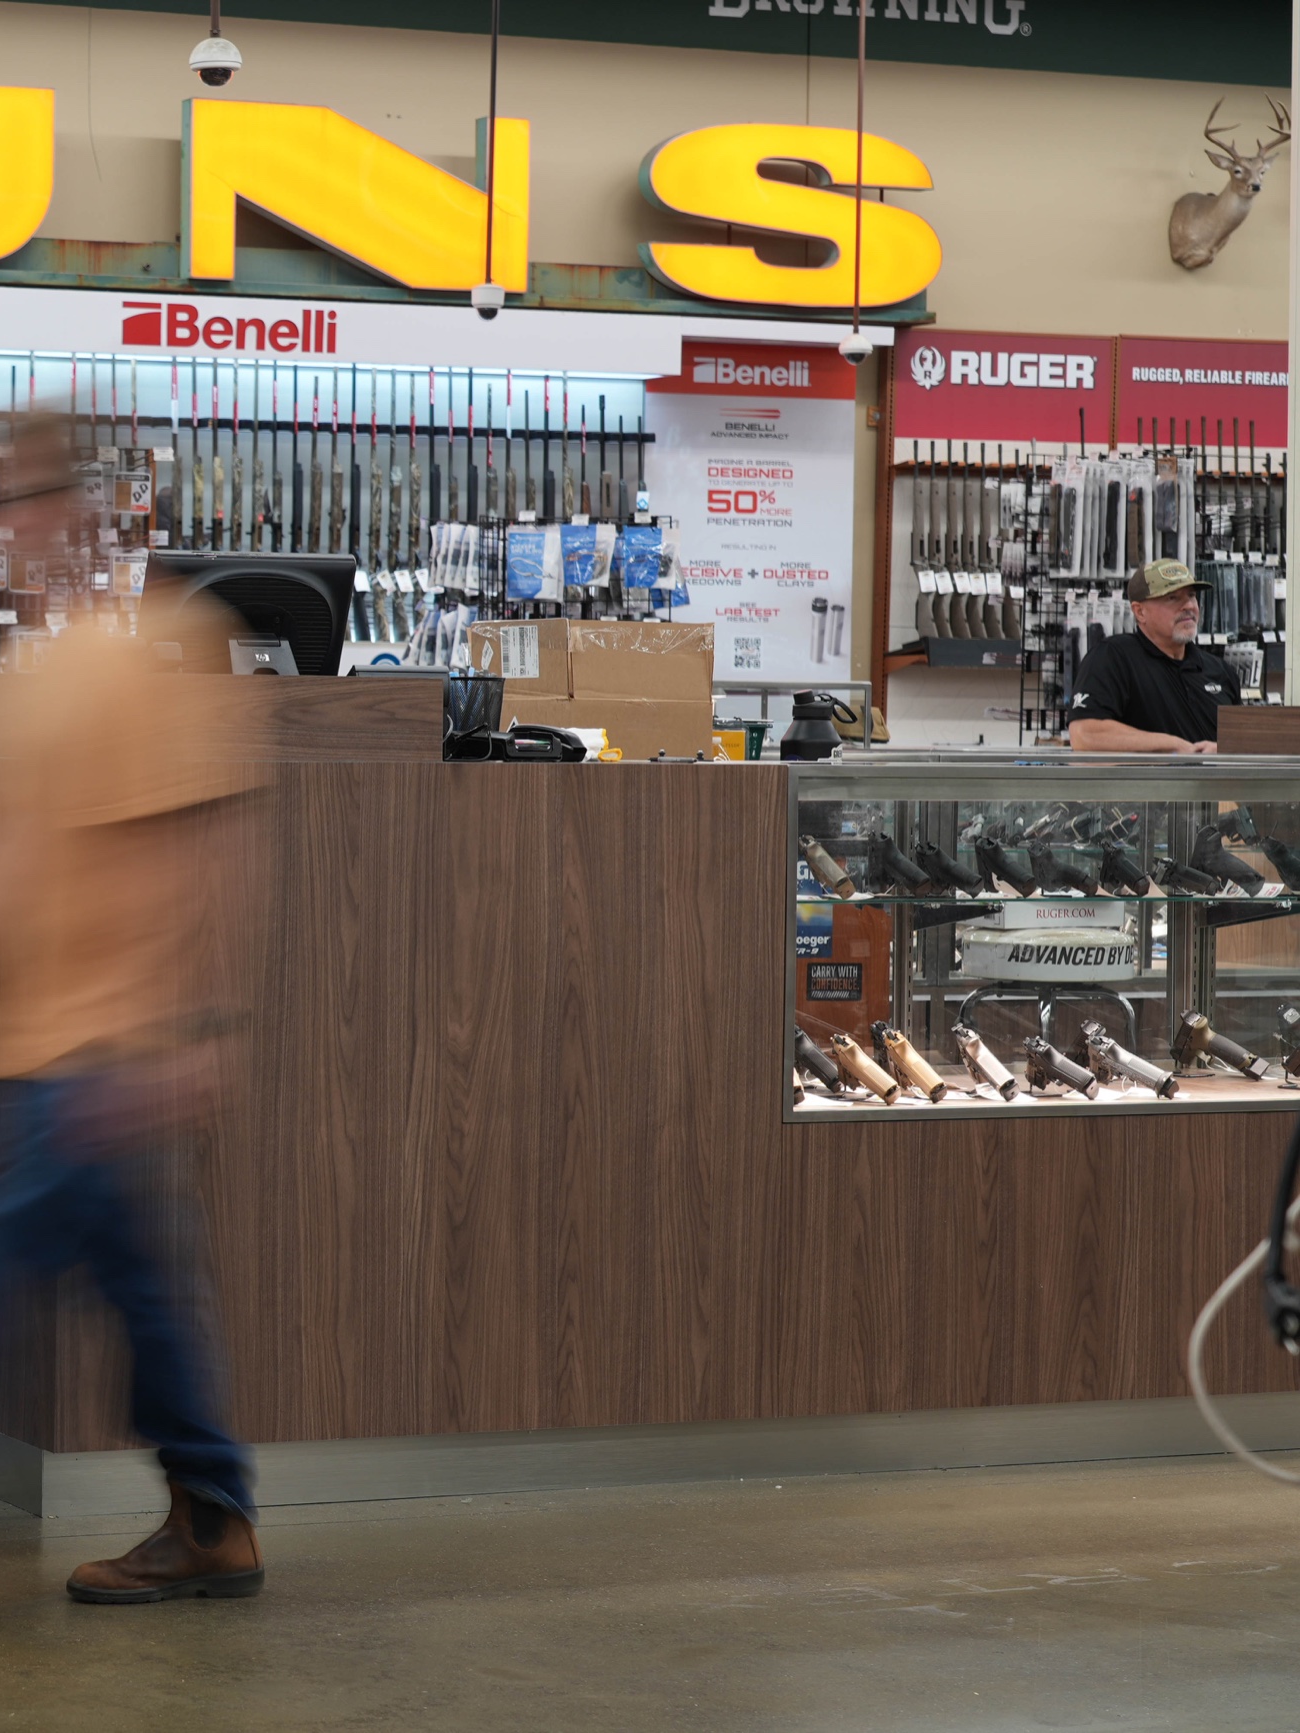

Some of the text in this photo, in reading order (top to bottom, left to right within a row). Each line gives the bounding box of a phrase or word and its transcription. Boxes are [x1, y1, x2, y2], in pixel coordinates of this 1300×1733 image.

[167, 303, 337, 353] Benelli
[717, 357, 810, 387] Benelli
[950, 350, 1095, 389] RUGER
[1132, 367, 1289, 386] RUGGED, RELIABLE FIREAR
[725, 422, 776, 432] BENELLI
[710, 431, 757, 439] ADVANCED
[707, 458, 744, 466] IMAGINE
[707, 466, 794, 479] DESIGNED
[707, 489, 793, 516] 50% MORE
[706, 518, 793, 527] PENETRATION
[689, 560, 721, 568] MORE
[780, 561, 812, 569] MORE
[681, 567, 743, 578] ECISIVE
[763, 568, 829, 580] DUSTED
[685, 578, 742, 586] KEDOWNS
[776, 580, 815, 588] CLAYS
[715, 608, 781, 617] LAB TEST
[1036, 908, 1096, 919] RUGER.COM
[796, 935, 831, 948] oeger
[1008, 944, 1106, 966] ADVANCED
[1107, 946, 1125, 965] BY
[811, 965, 858, 978] CARRY WITH
[811, 977, 860, 990] CONFIDENCE.
